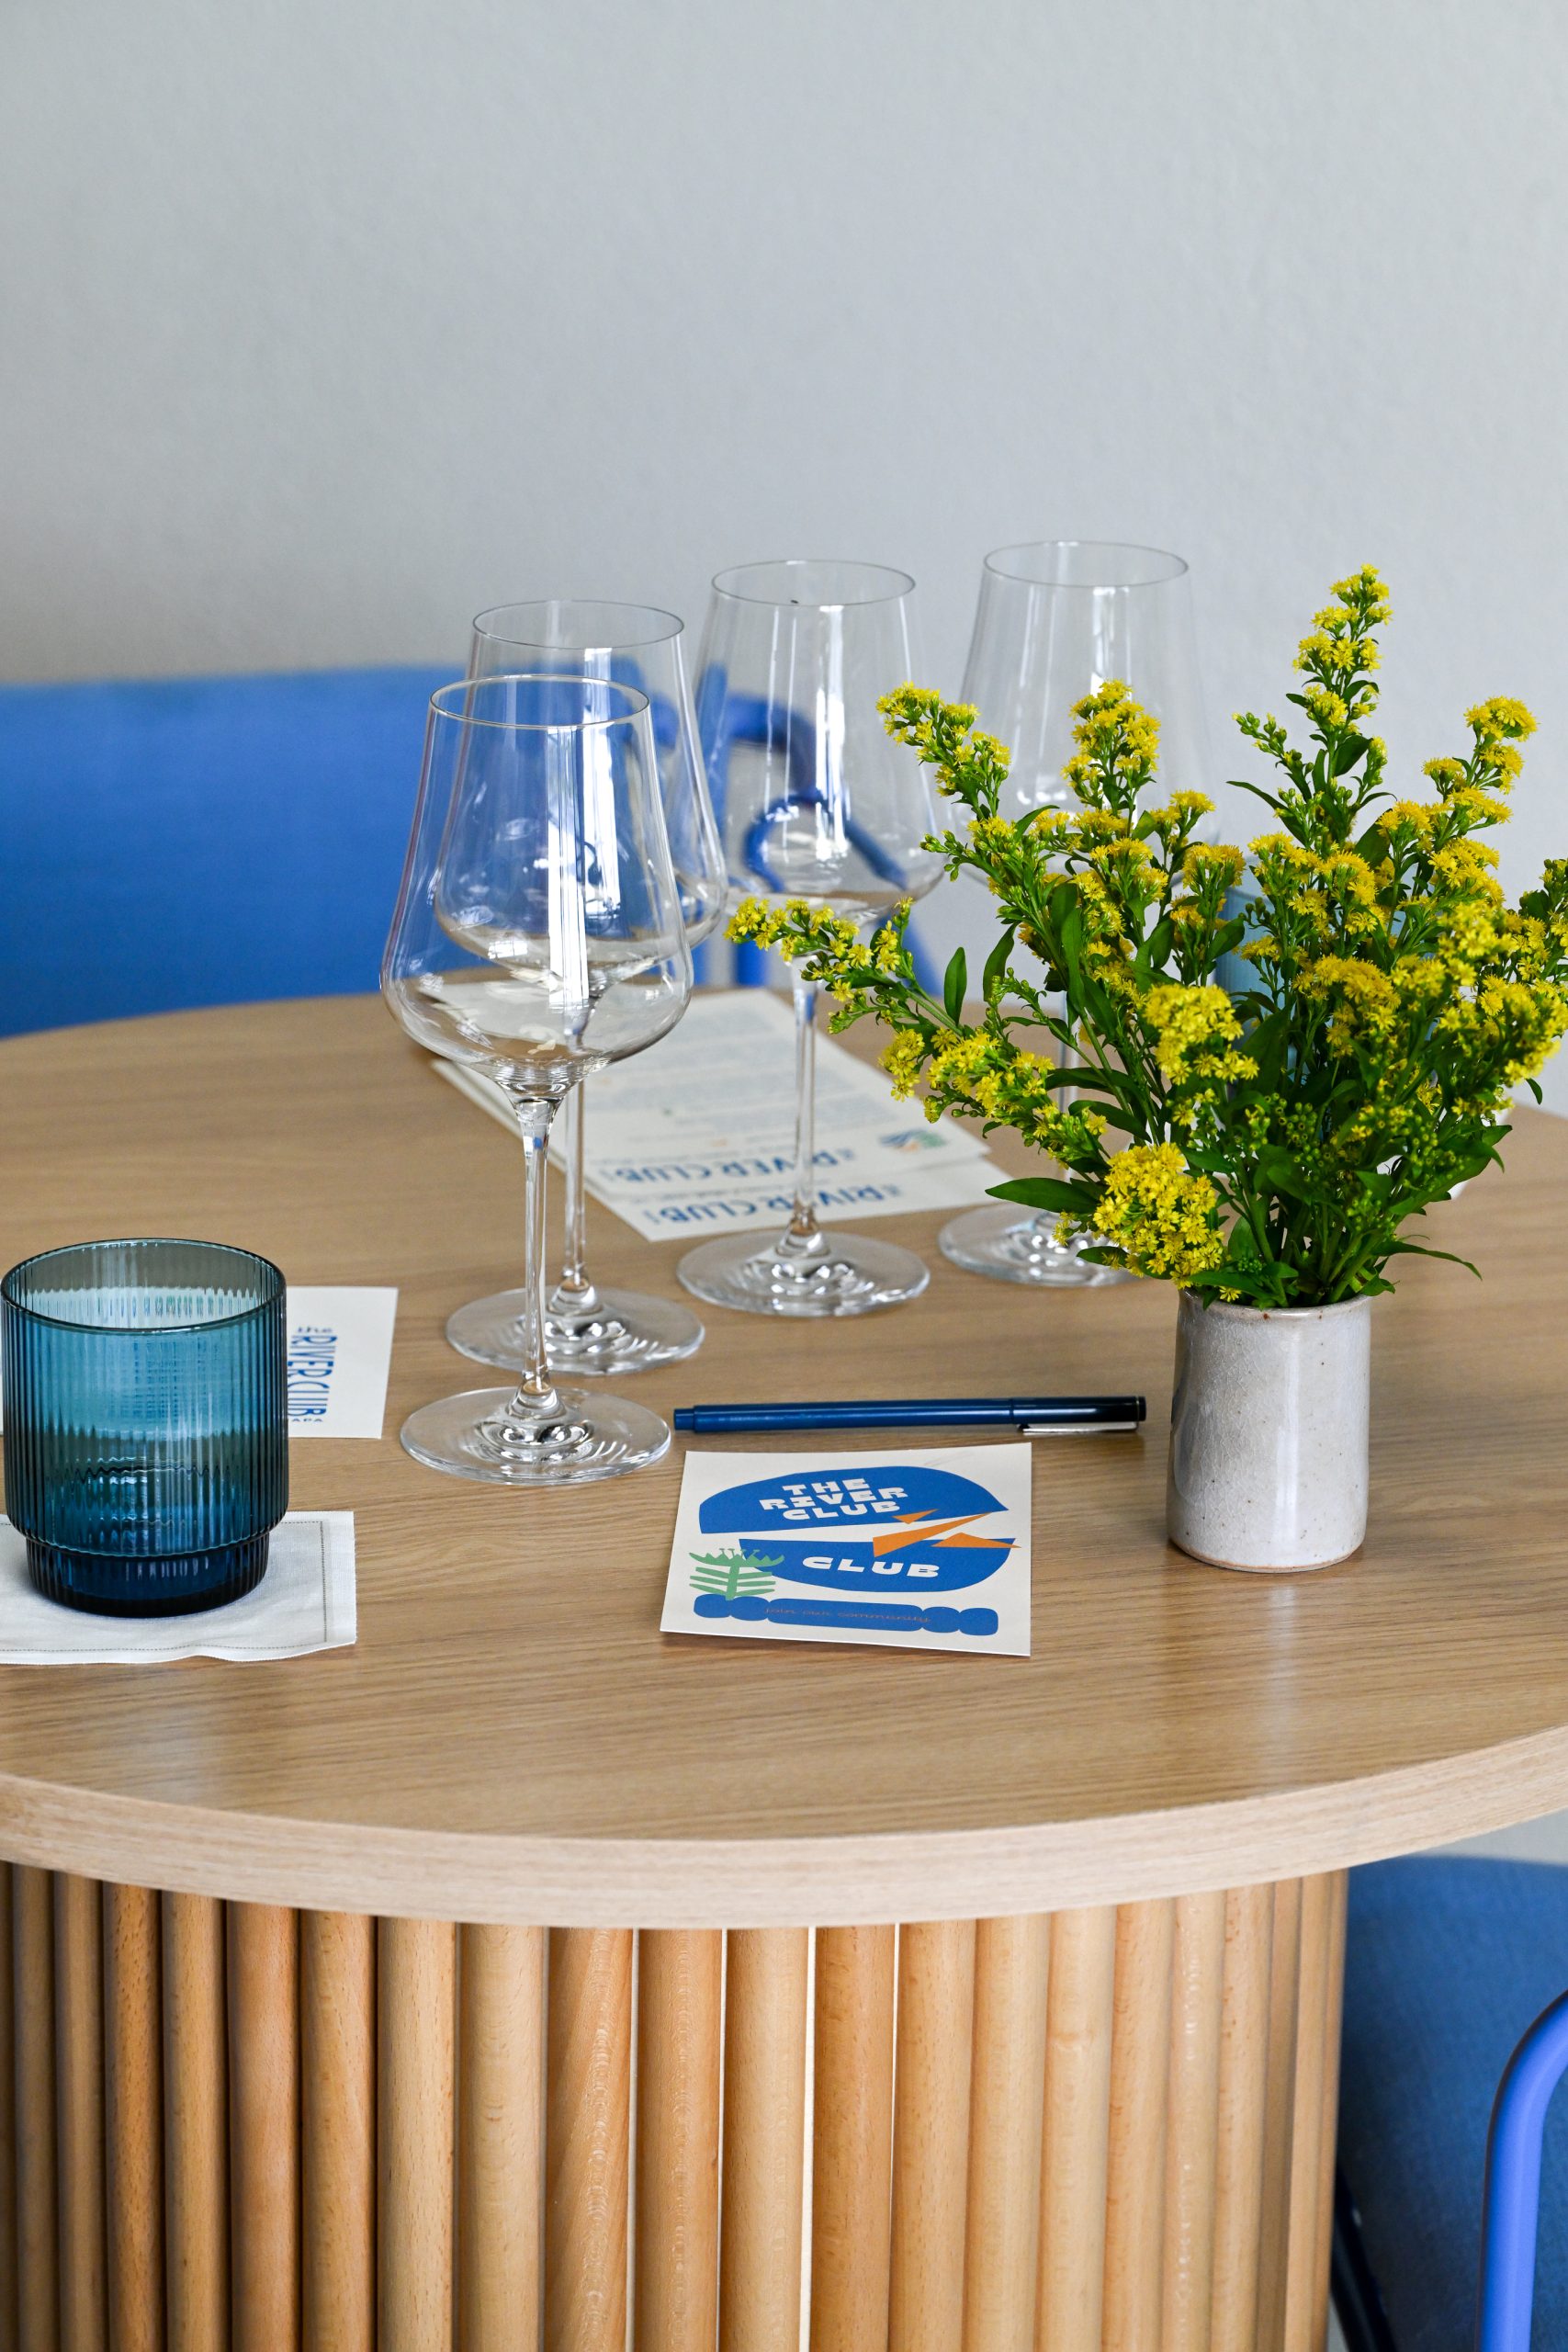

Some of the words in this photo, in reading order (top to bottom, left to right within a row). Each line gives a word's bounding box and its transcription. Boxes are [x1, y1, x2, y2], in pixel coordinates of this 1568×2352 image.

[615, 1162, 712, 1183] CLUB
[721, 1151, 839, 1177] RVER
[766, 1183, 886, 1211] RIVR
[660, 1198, 758, 1224] CLUB
[288, 1335, 338, 1378] RIVER
[759, 1483, 908, 1510] RIVER
[782, 1476, 870, 1496] THE
[782, 1500, 900, 1521] CLUB
[801, 1555, 941, 1578] CLUB
